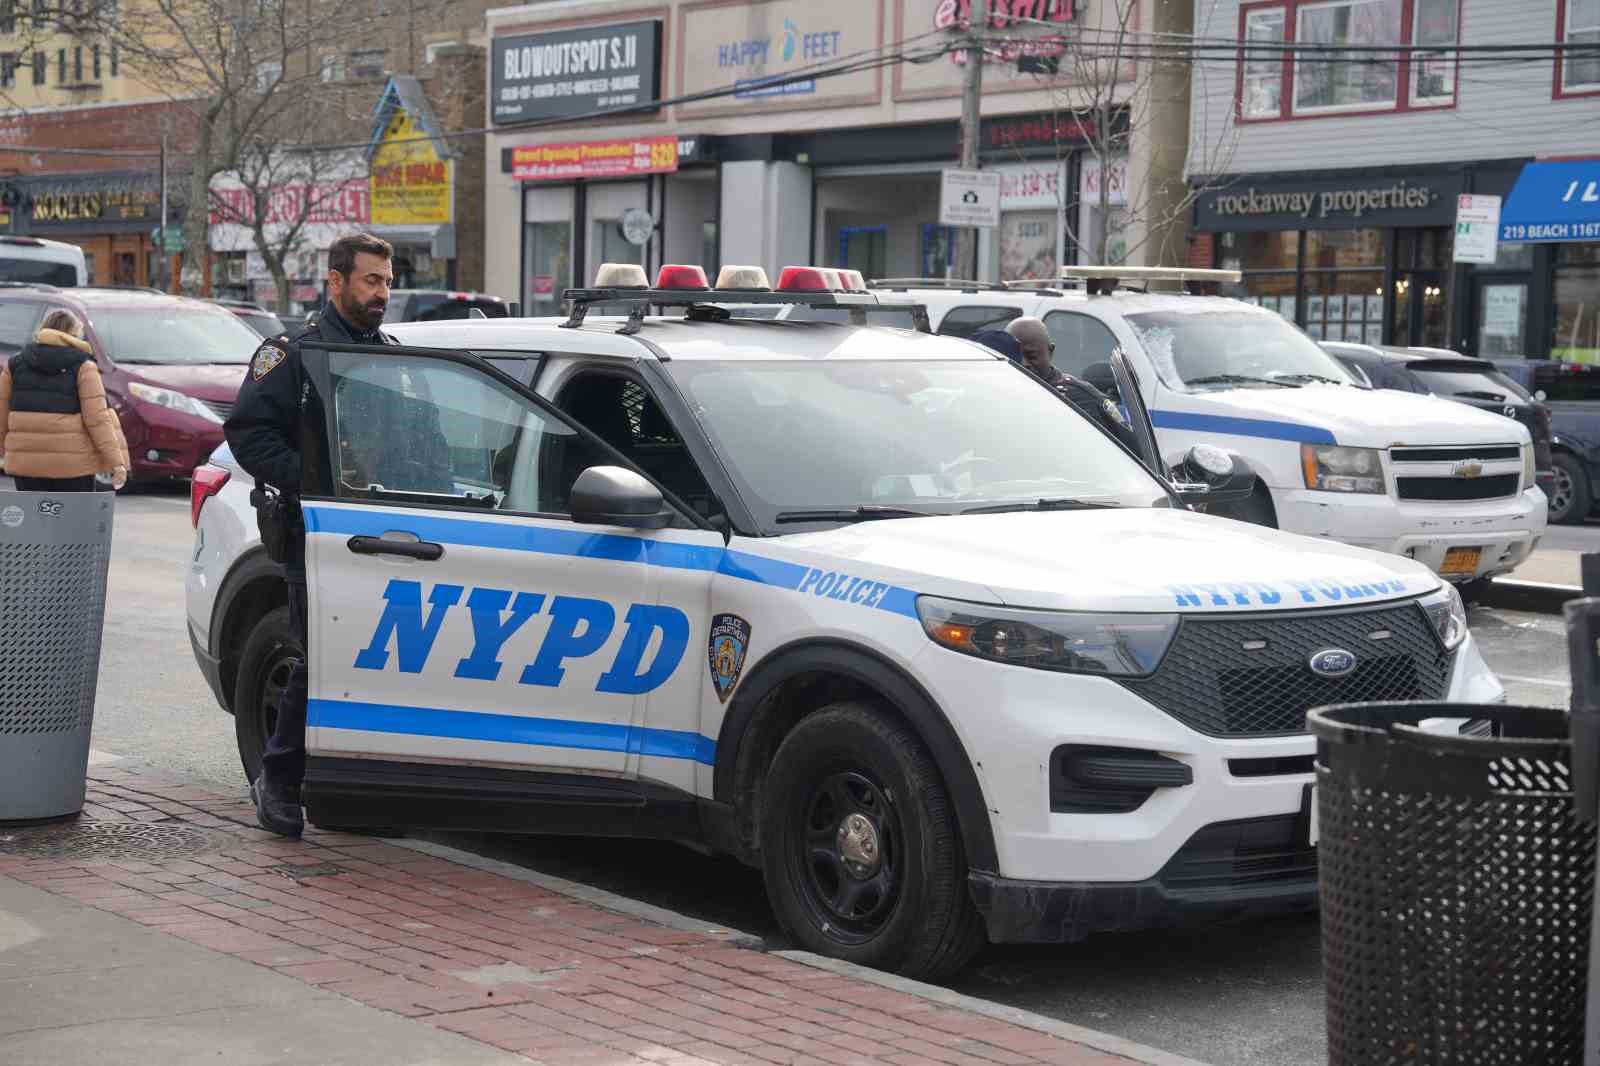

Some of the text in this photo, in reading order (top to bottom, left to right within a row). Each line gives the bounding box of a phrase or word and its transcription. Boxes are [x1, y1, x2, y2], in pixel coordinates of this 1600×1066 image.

[504, 39, 608, 79] BLOWOUTSPOT
[719, 31, 840, 67] HAPPY FEET
[652, 142, 676, 167] $20
[33, 191, 101, 220] ROGERS
[1216, 187, 1313, 218] rockaway
[1319, 181, 1429, 217] properties
[1504, 225, 1525, 239] 219
[1528, 224, 1568, 238] BEACH
[800, 568, 886, 608] POLICE
[353, 578, 690, 696] NYPD
[1322, 654, 1349, 672] Ford
